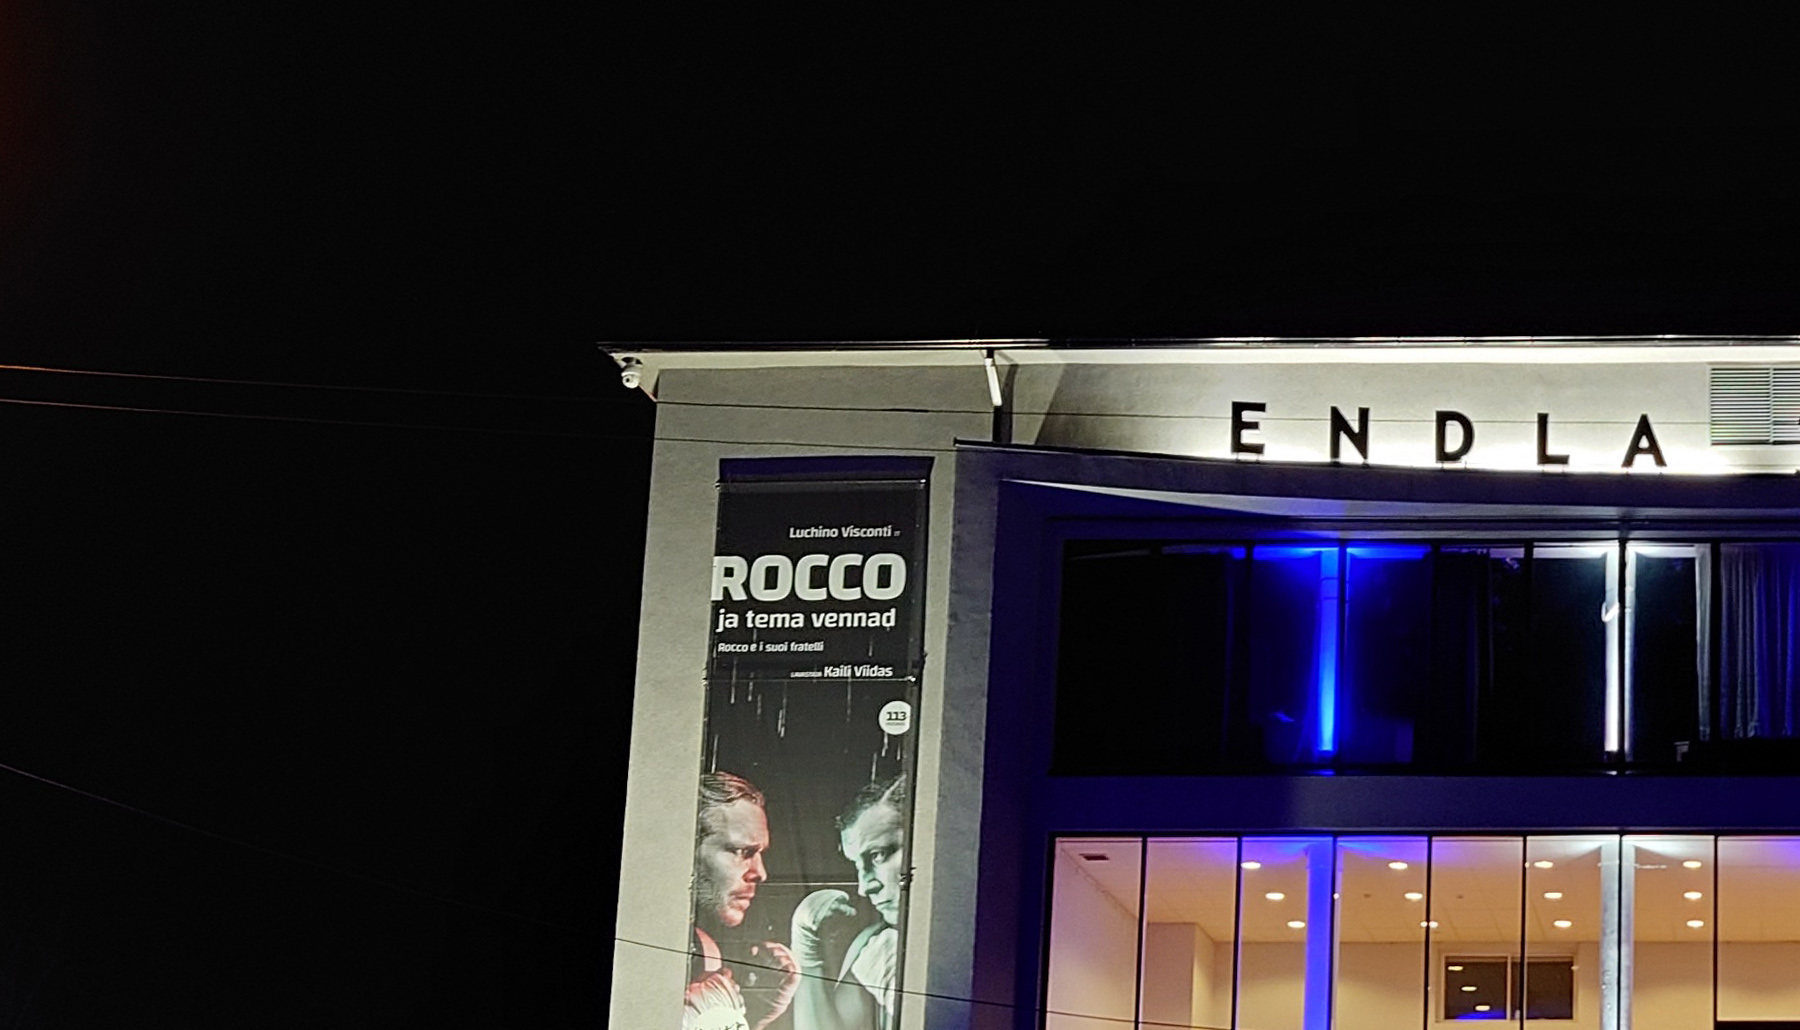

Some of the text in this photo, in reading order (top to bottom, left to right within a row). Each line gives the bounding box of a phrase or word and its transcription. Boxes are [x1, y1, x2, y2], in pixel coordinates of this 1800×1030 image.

[1230, 401, 1668, 468] ENDLA
[789, 525, 839, 538] Luchino
[841, 525, 892, 538] Visconti
[711, 553, 907, 602] ROCCO
[715, 607, 896, 633] ja tema vennad
[718, 641, 824, 652] Rocco e i suoi fratelli
[824, 664, 852, 677] Kaili
[854, 664, 893, 677] Viidas
[886, 711, 907, 721] 113
